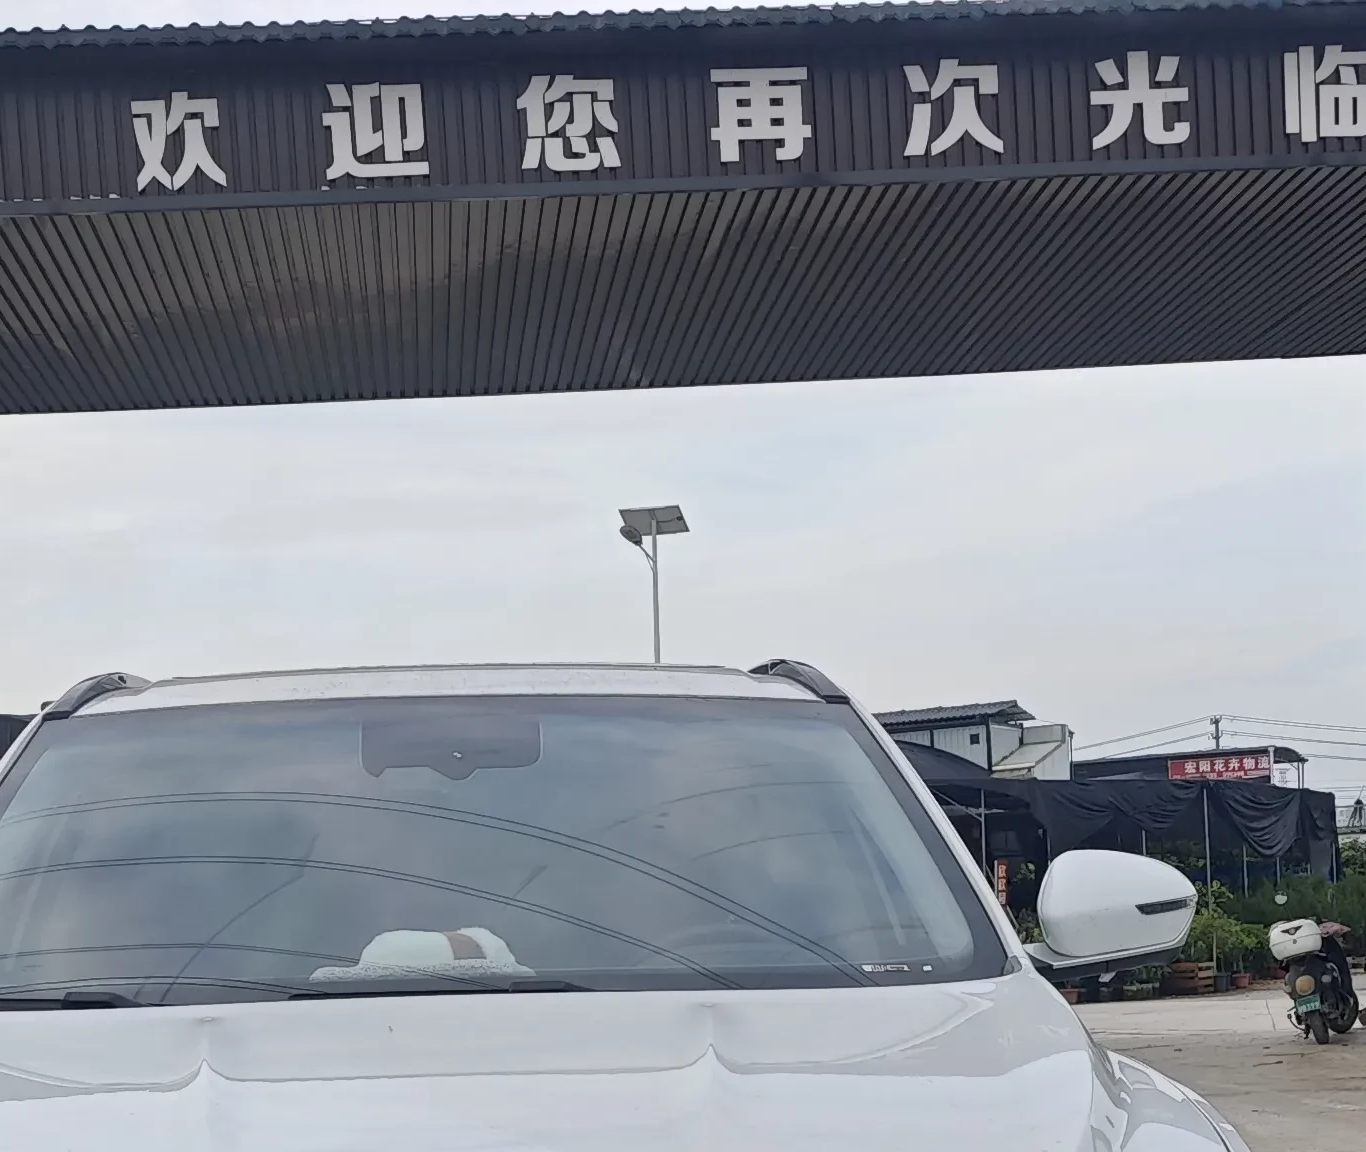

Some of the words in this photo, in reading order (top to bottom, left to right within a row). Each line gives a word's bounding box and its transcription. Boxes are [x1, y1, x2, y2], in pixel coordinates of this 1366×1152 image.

[1184, 756, 1270, 774] 宏阳花卉物流
